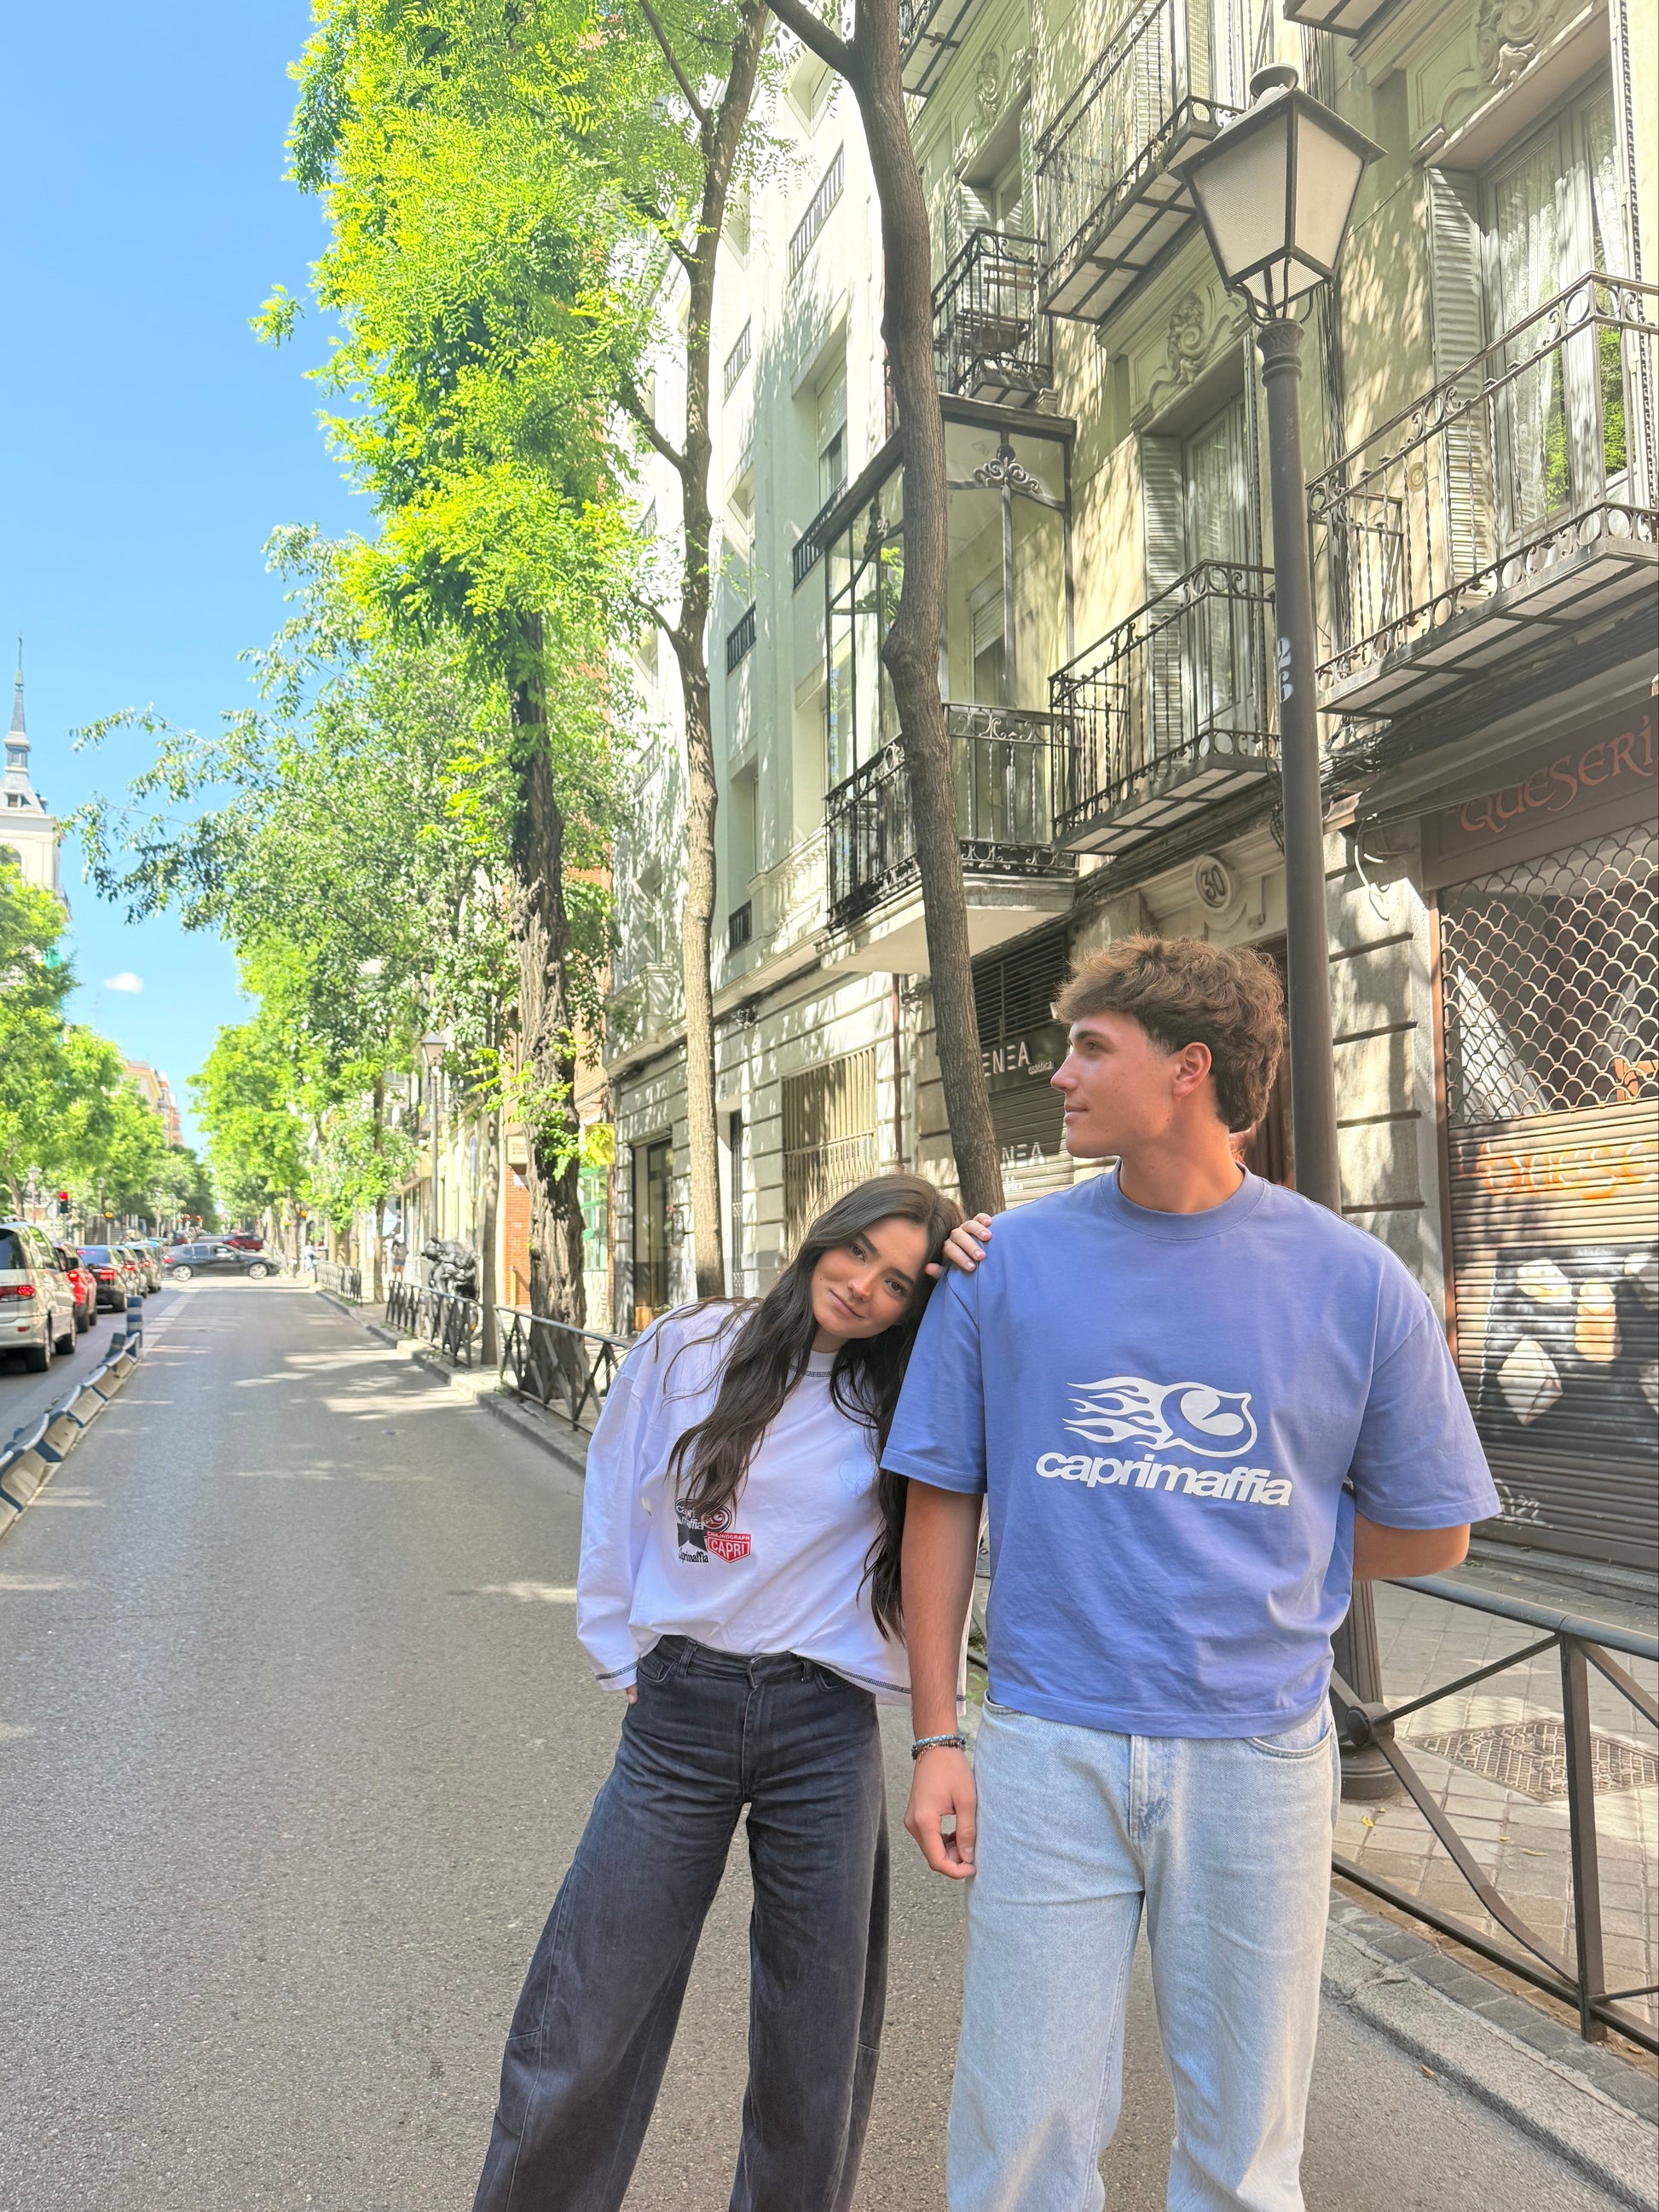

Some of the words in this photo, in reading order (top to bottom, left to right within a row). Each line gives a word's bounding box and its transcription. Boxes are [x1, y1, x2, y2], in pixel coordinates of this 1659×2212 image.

[1460, 714, 1659, 833] QUESERI
[1200, 864, 1225, 901] 30
[1036, 1452, 1293, 1506] caprimaffia
[710, 1539, 745, 1559] CAPRI
